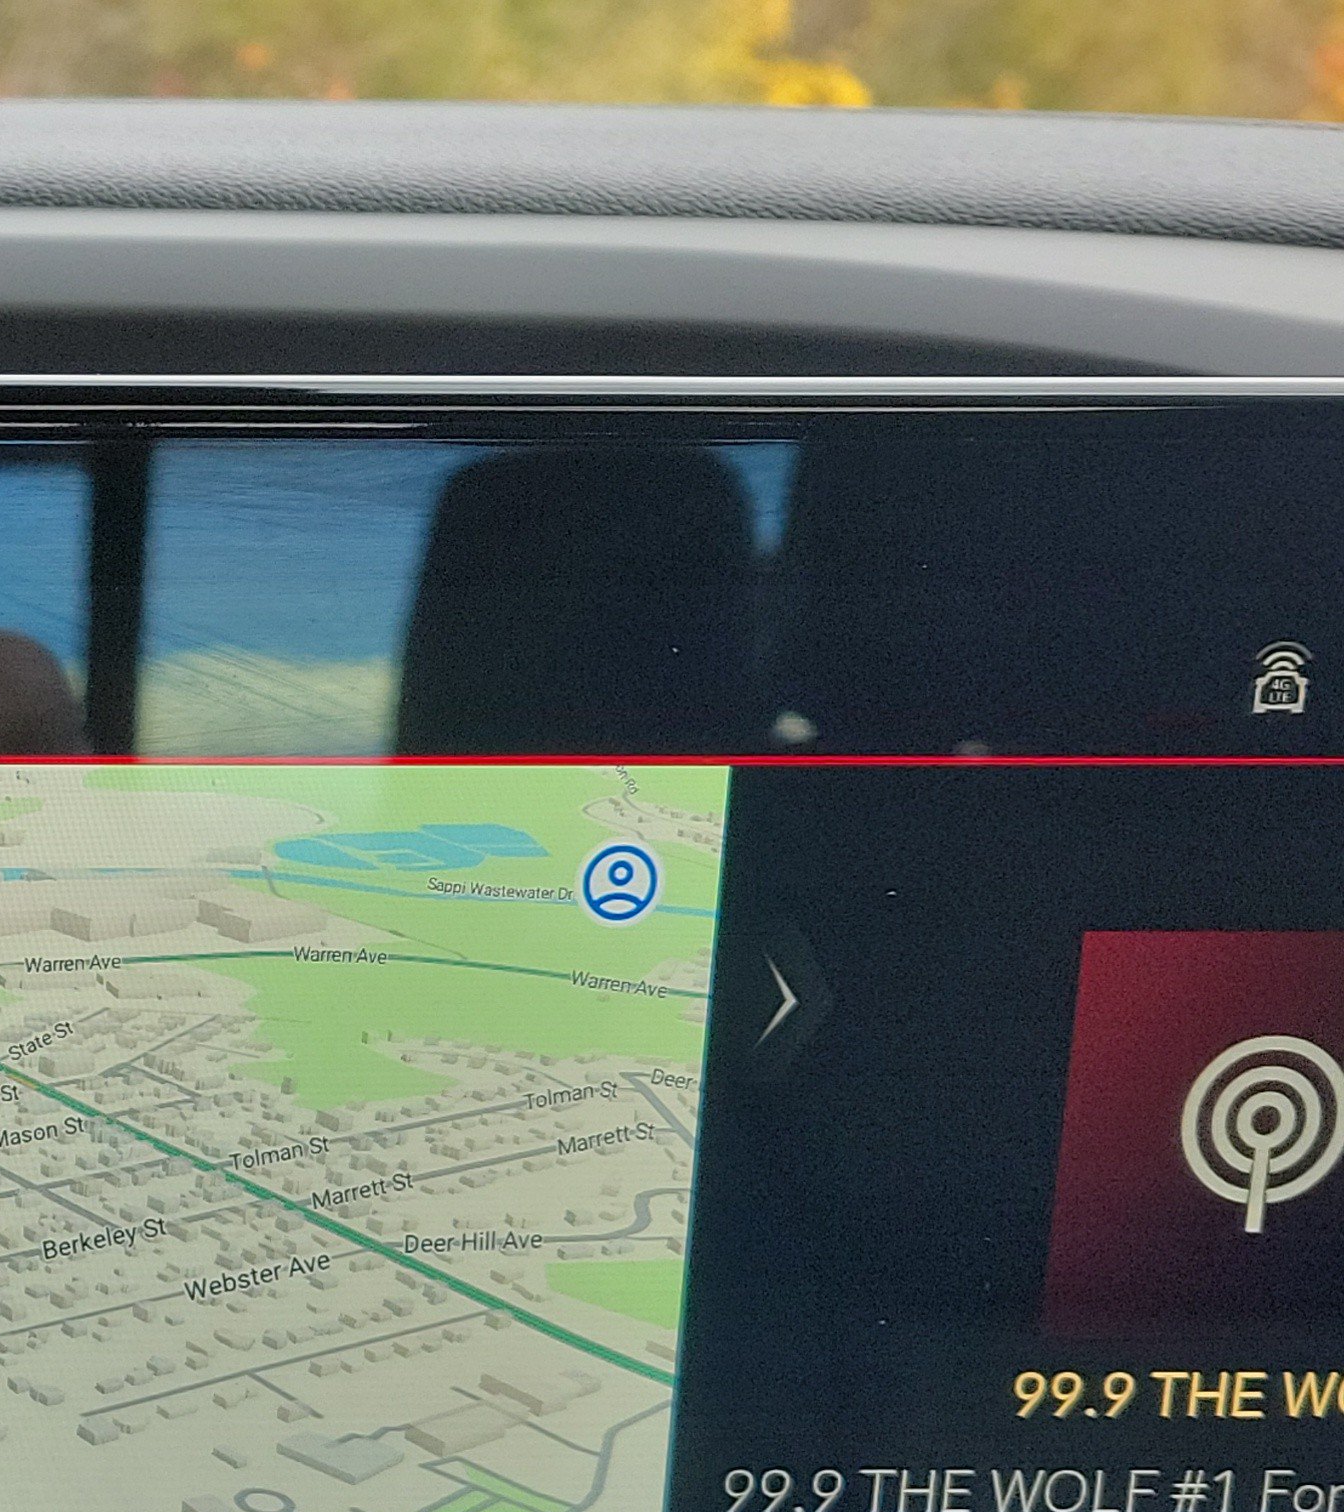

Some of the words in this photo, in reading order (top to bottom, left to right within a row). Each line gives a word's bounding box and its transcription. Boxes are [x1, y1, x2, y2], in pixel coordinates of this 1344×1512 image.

[427, 877, 466, 894] Sappi
[470, 882, 555, 900] Wastewater
[558, 887, 574, 900] Dr
[25, 956, 82, 973] Warren
[88, 955, 122, 971] Ave
[293, 946, 352, 965] Warren
[355, 948, 388, 966] Ave
[571, 970, 630, 994] Warren
[631, 980, 668, 1000] Ave
[8, 1032, 52, 1061] State
[54, 1022, 75, 1042] St
[650, 1068, 694, 1090] Deer
[524, 1084, 590, 1110] Tolman
[595, 1081, 618, 1099] St
[62, 1117, 84, 1138] St
[557, 1126, 632, 1157] Marrett
[634, 1122, 656, 1142] St
[229, 1142, 305, 1172] Tolman
[309, 1136, 330, 1156] St
[311, 1178, 389, 1211] Marrett
[391, 1173, 414, 1193] St
[41, 1223, 138, 1261] Berkeley
[141, 1217, 168, 1240] St
[404, 1233, 457, 1254] Deer
[460, 1231, 497, 1251] Hill
[500, 1230, 543, 1251] Ave
[183, 1261, 283, 1302] Webster
[287, 1252, 332, 1278] Ave
[1014, 1370, 1136, 1420] 99.9
[1150, 1370, 1269, 1420] THE
